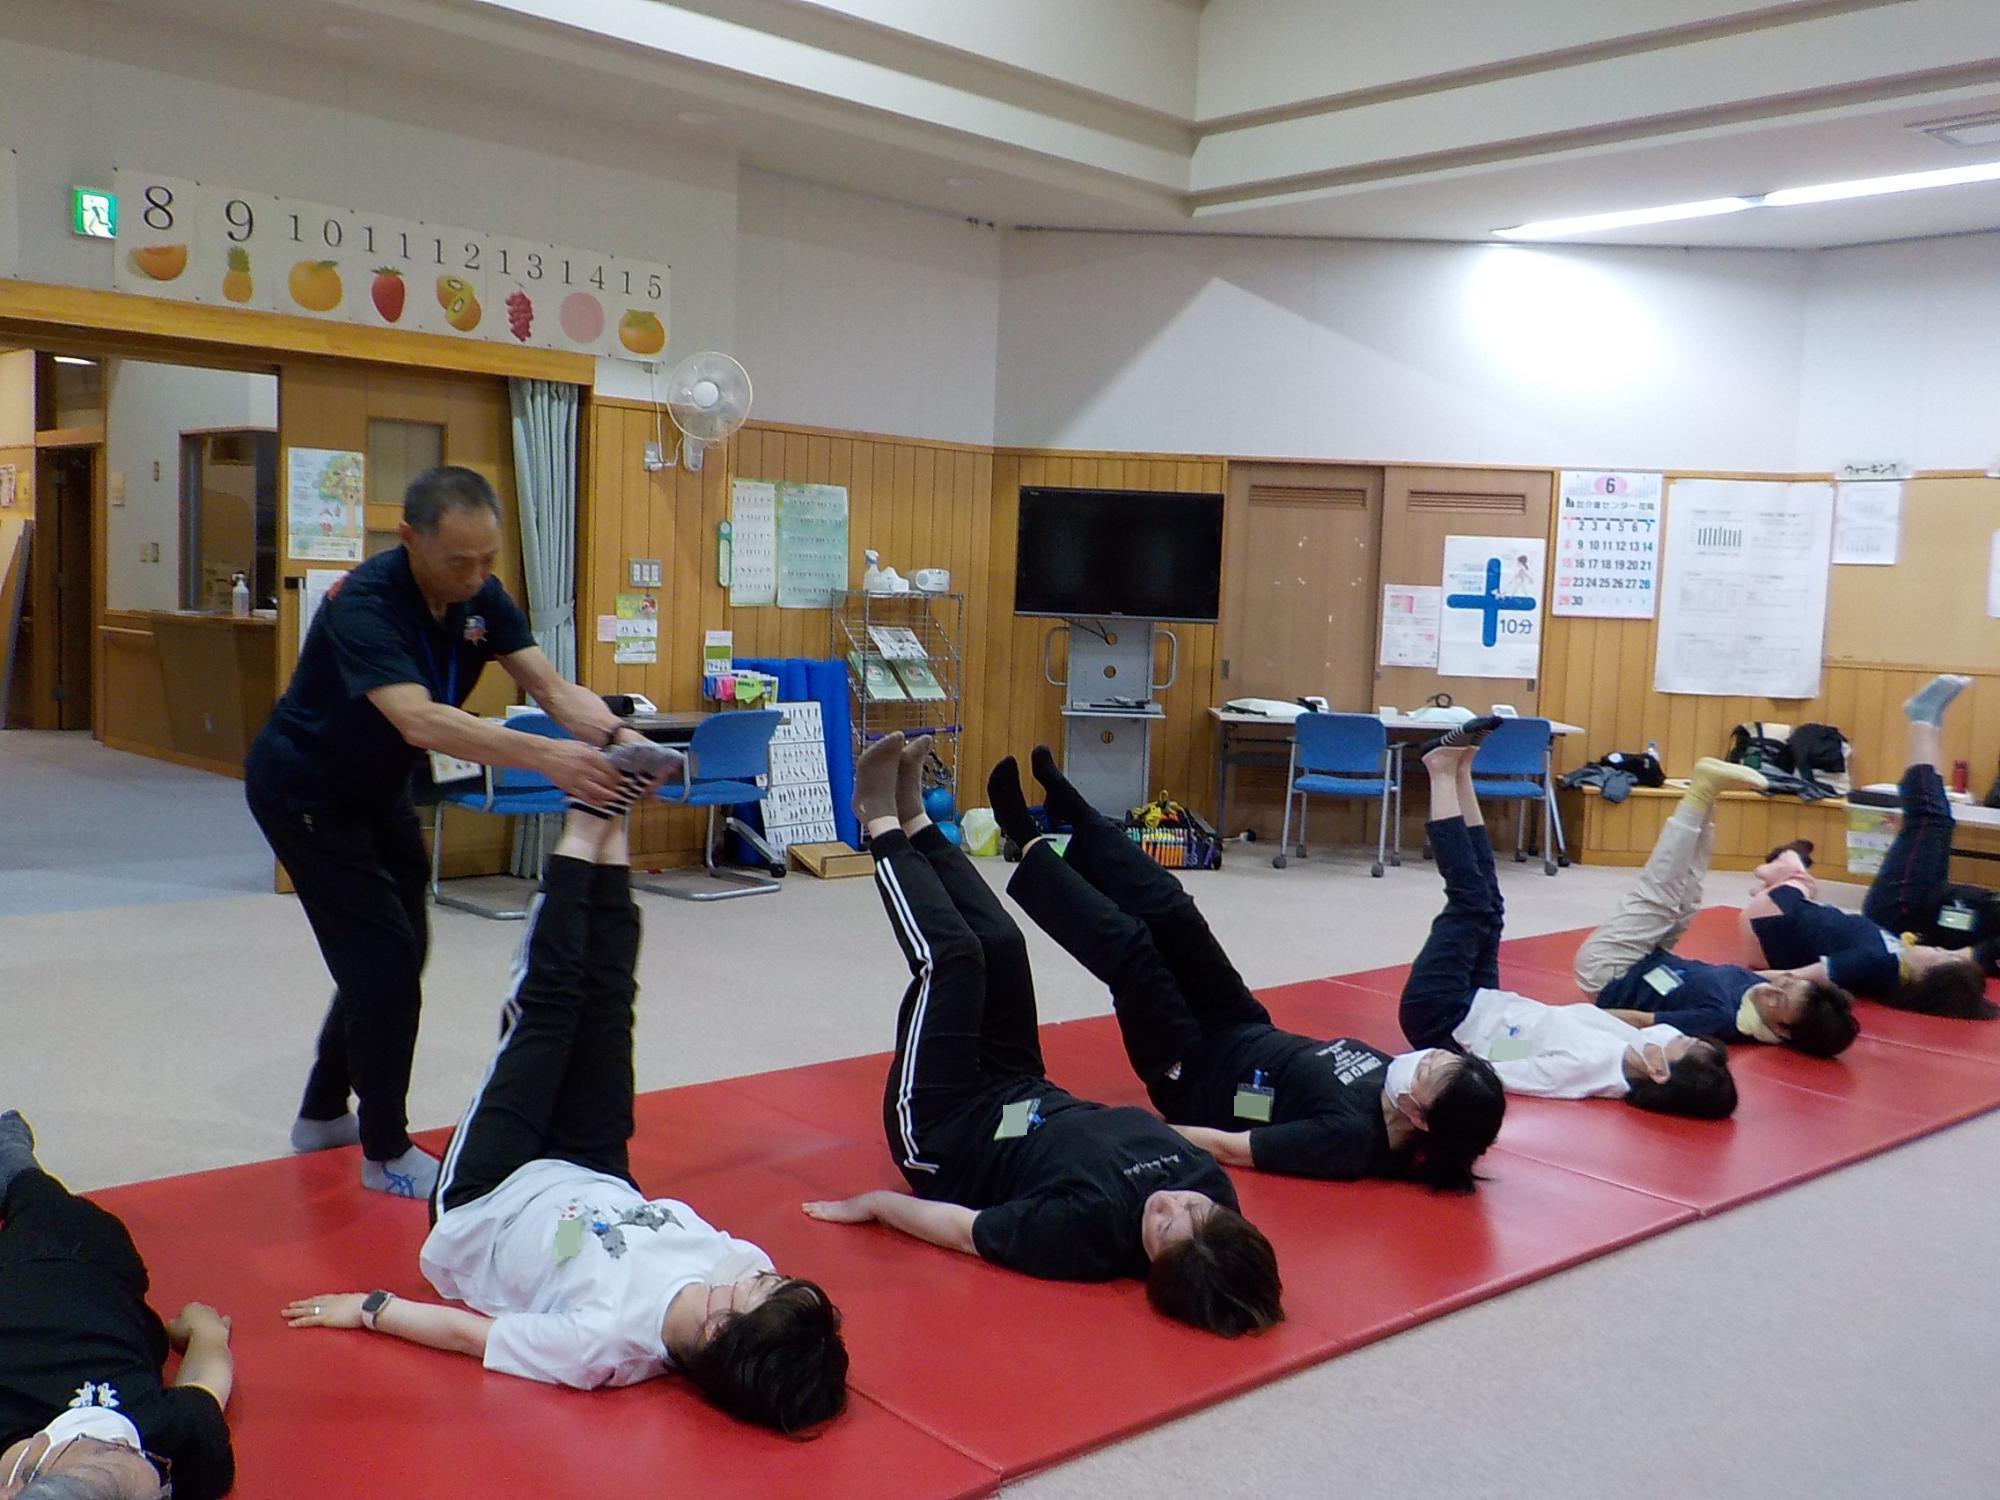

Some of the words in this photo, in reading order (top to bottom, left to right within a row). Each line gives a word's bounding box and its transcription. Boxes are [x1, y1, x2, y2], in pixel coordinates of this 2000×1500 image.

[144, 185, 174, 230] 8
[225, 199, 255, 242] 9
[289, 214, 343, 248] 10
[363, 226, 411, 259] 11
[434, 238, 480, 270] 12
[499, 249, 544, 280] 13
[561, 260, 605, 291] 14
[621, 270, 662, 300] 15
[1605, 477, 1616, 494] 6
[1578, 520, 1585, 531] 2
[1592, 520, 1598, 531] 3
[1605, 522, 1611, 532] 4
[1618, 522, 1624, 532] 5
[1632, 522, 1638, 532] 6
[1646, 522, 1651, 533] 7
[1577, 540, 1584, 550] 9
[1589, 540, 1600, 550] 10
[1602, 541, 1612, 551] 11
[1616, 541, 1626, 551] 12
[1629, 542, 1640, 552] 13
[1643, 542, 1653, 552] 14
[1575, 558, 1585, 568] 16
[1588, 559, 1598, 569] 17
[1601, 559, 1612, 569] 18
[1615, 560, 1625, 570] 19
[1626, 560, 1639, 570] 20
[1640, 560, 1651, 571] 21
[1572, 577, 1584, 588] 23
[1585, 577, 1597, 588] 24
[1599, 578, 1610, 588] 25
[1612, 578, 1624, 589] 26
[1625, 578, 1638, 589] 27
[1639, 579, 1651, 589] 28
[1571, 595, 1584, 606] 30
[1500, 618, 1534, 635] 10分
